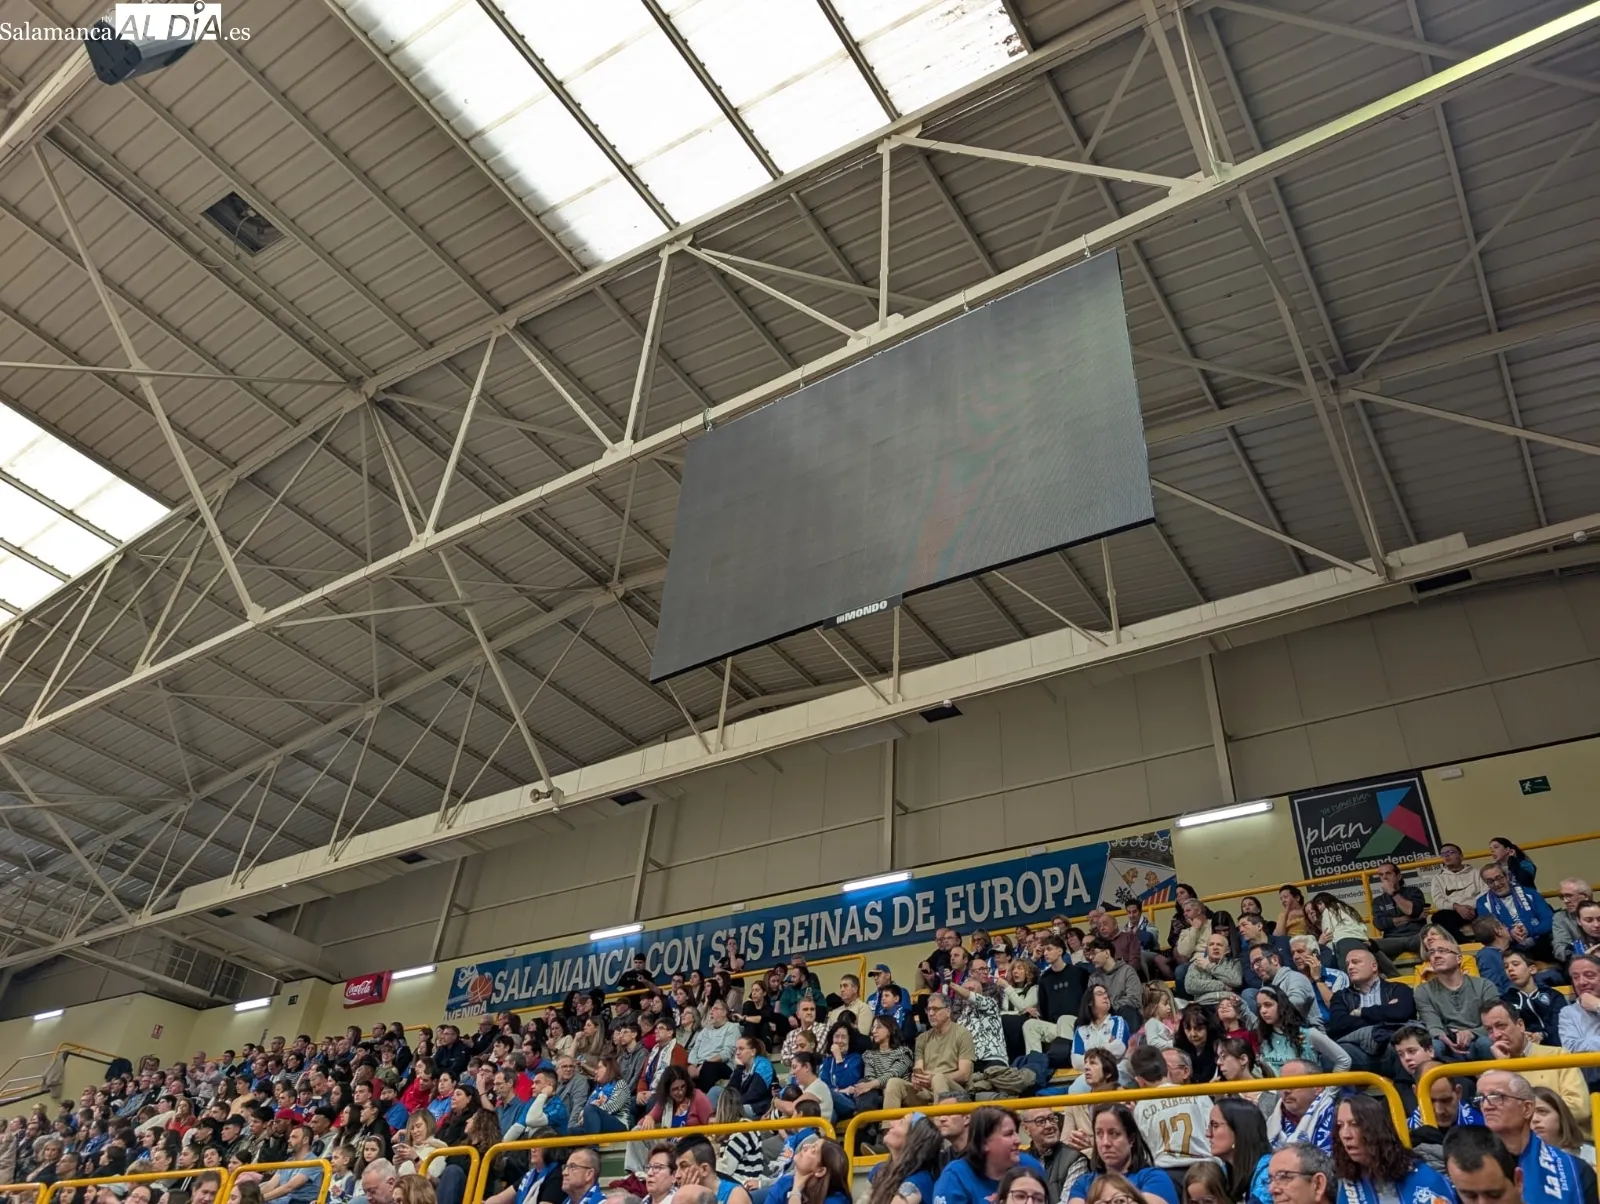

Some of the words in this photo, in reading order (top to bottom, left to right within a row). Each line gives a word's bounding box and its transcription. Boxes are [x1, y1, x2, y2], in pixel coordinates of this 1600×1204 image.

[844, 600, 888, 622] MONDO
[1306, 817, 1372, 853] plan
[1310, 838, 1361, 856] municipal
[1312, 853, 1343, 866] sobre
[645, 934, 705, 978] CON
[771, 900, 884, 957] REINAS
[892, 890, 935, 937] DE
[945, 863, 1091, 927] EUROPA
[443, 1000, 488, 1021] AVENIDA
[1544, 1175, 1563, 1200] La
